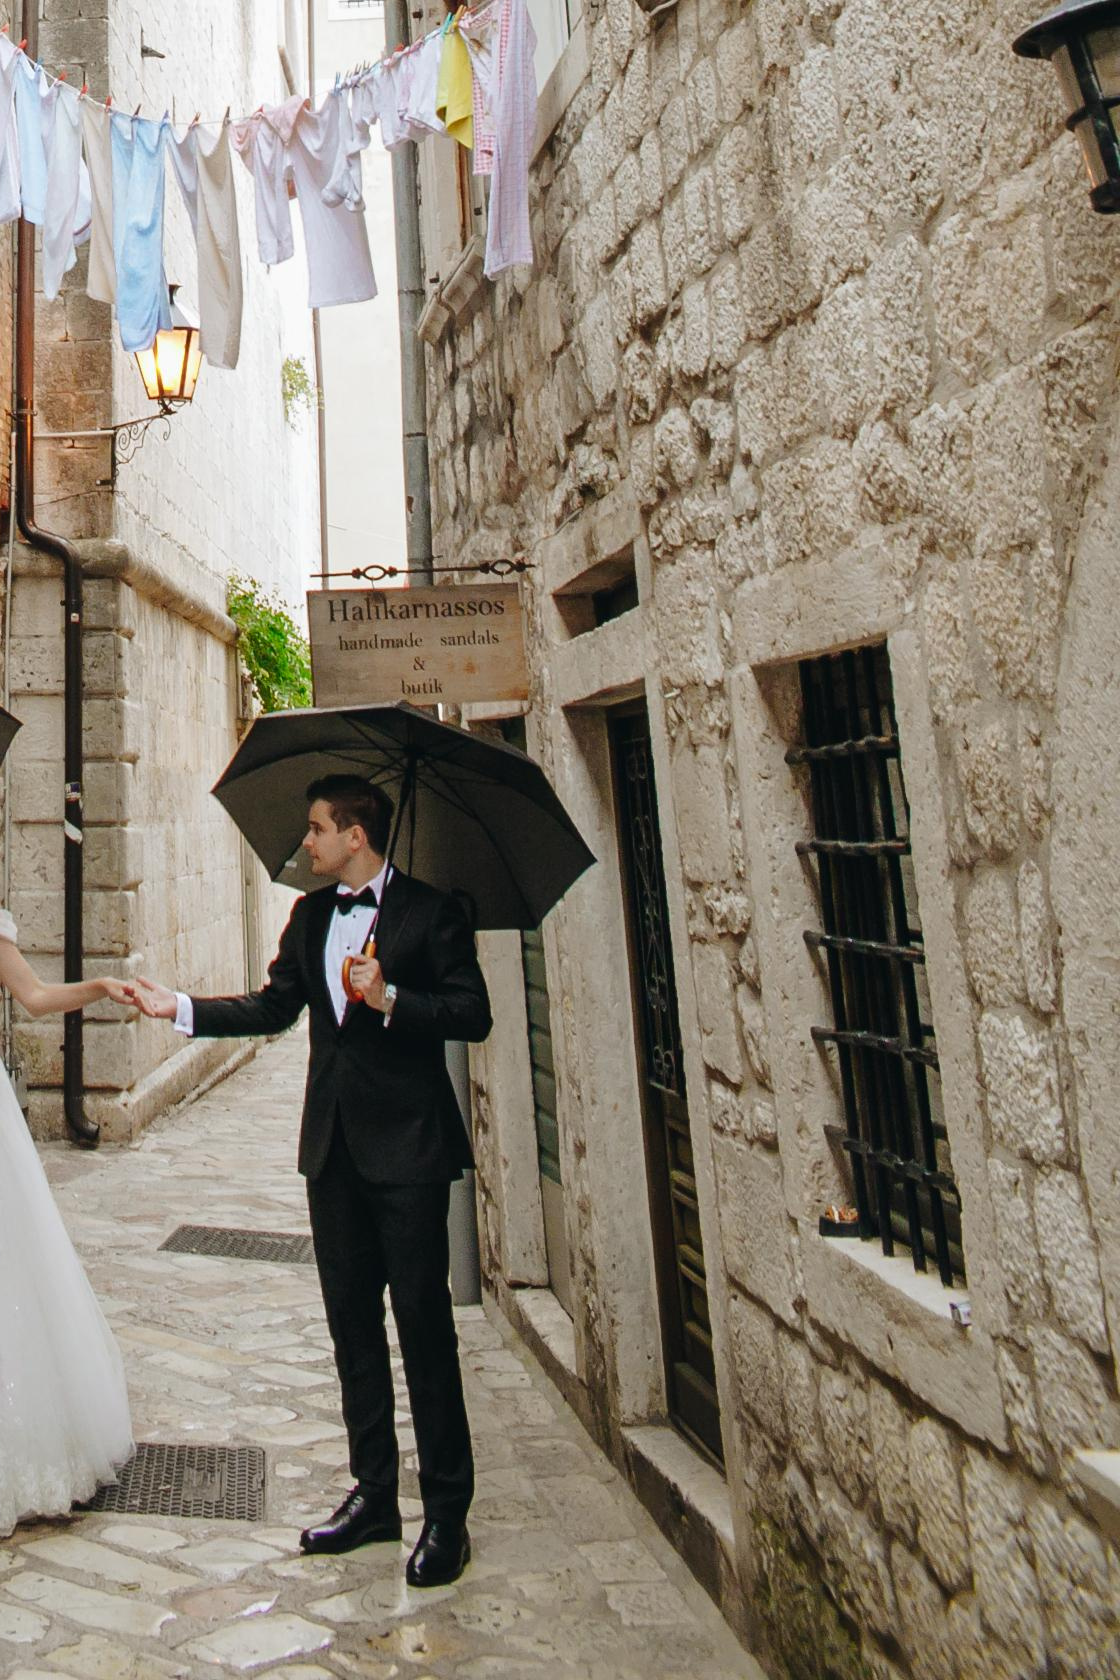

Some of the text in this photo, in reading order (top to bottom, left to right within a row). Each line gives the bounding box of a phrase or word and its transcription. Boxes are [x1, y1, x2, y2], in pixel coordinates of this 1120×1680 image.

[329, 599, 505, 623] Halikarnassos
[339, 629, 500, 651] handmade sandals
[413, 656, 425, 671] &
[401, 678, 443, 695] butik
